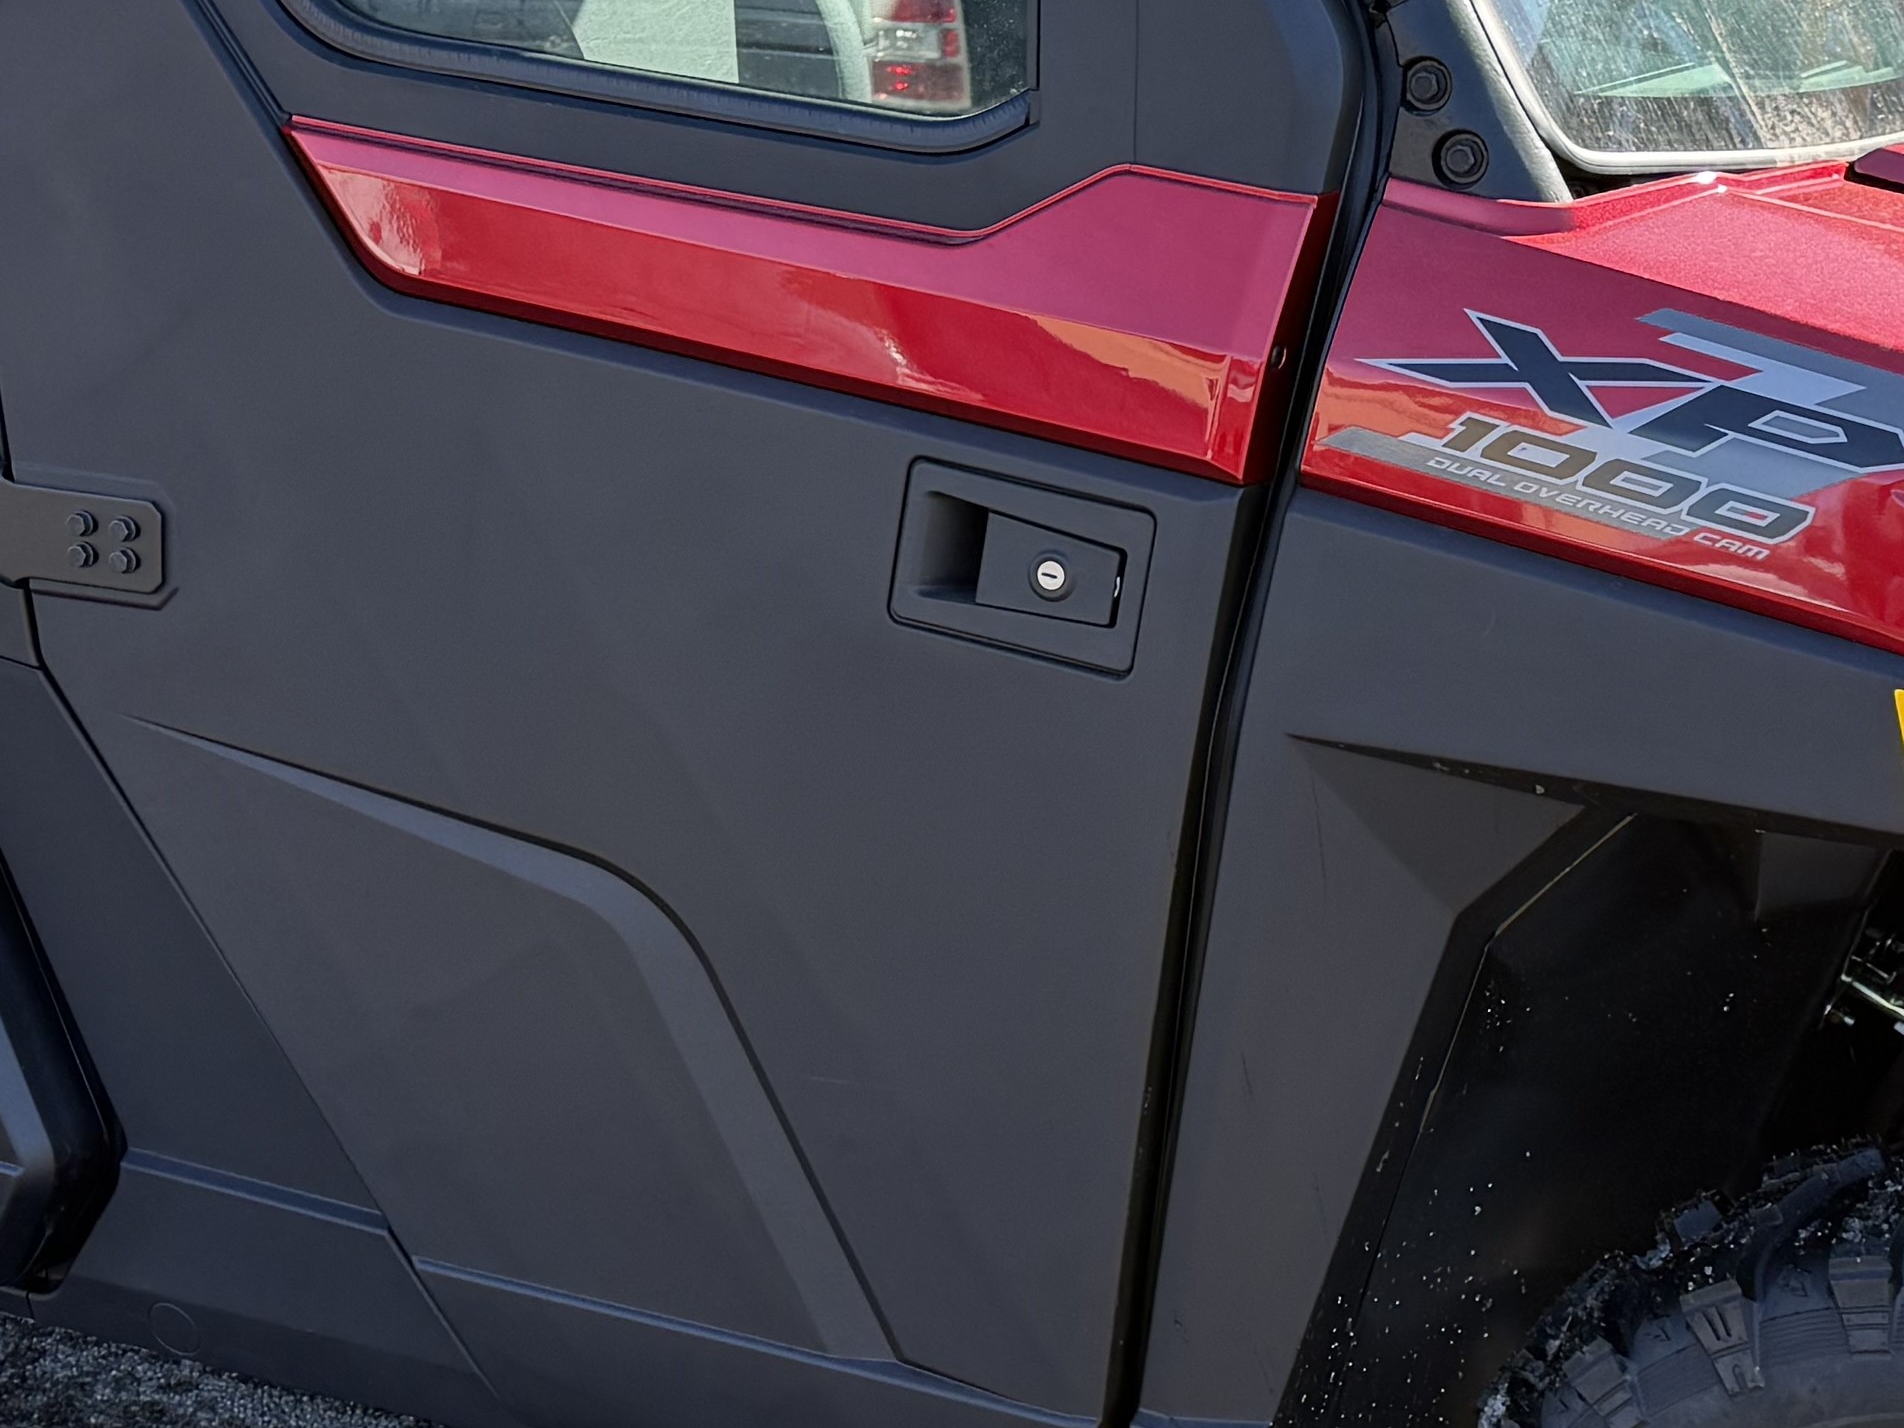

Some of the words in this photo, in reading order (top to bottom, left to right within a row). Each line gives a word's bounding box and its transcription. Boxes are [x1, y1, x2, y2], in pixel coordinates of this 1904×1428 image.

[1426, 456, 1508, 487] DUAL
[1515, 480, 1692, 537] OVERHEAD
[1693, 531, 1771, 562] CAM
[1434, 411, 1816, 545] 1000
